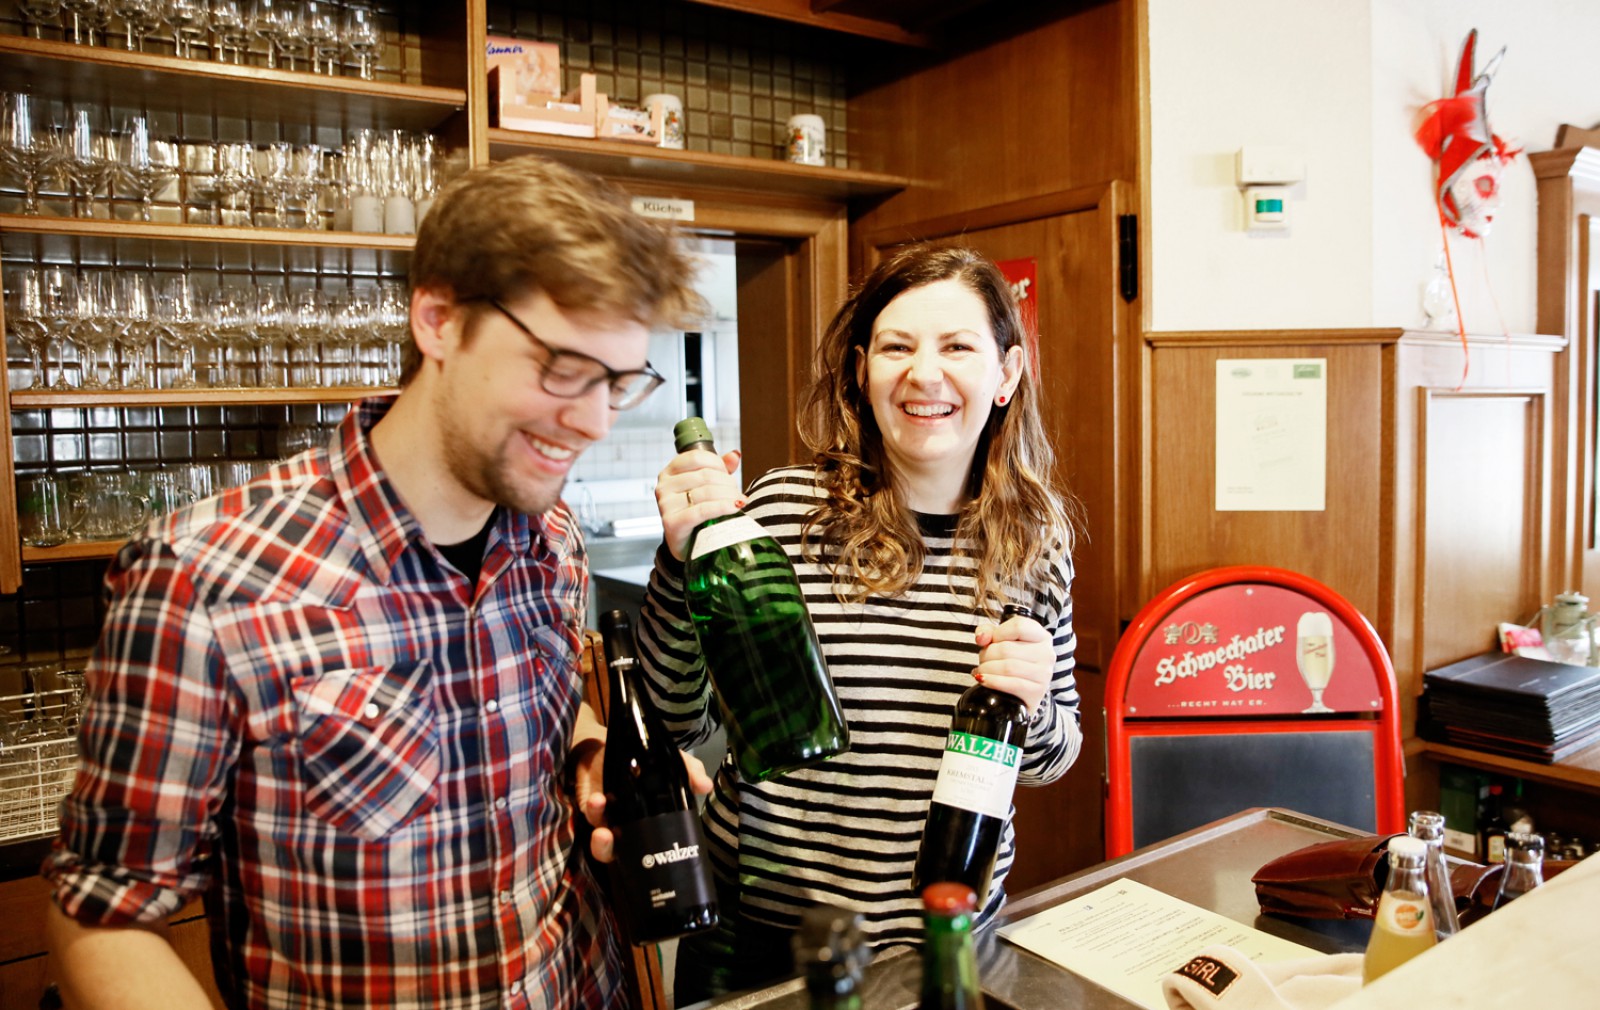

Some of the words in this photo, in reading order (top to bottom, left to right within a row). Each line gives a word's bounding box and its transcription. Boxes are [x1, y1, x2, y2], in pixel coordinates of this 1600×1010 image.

[643, 202, 683, 213] Küche
[1154, 625, 1286, 687] Schwechater
[1223, 664, 1276, 692] Bier
[1222, 699, 1244, 707] HAT
[947, 733, 1016, 765] WALZER
[653, 841, 699, 865] walzer
